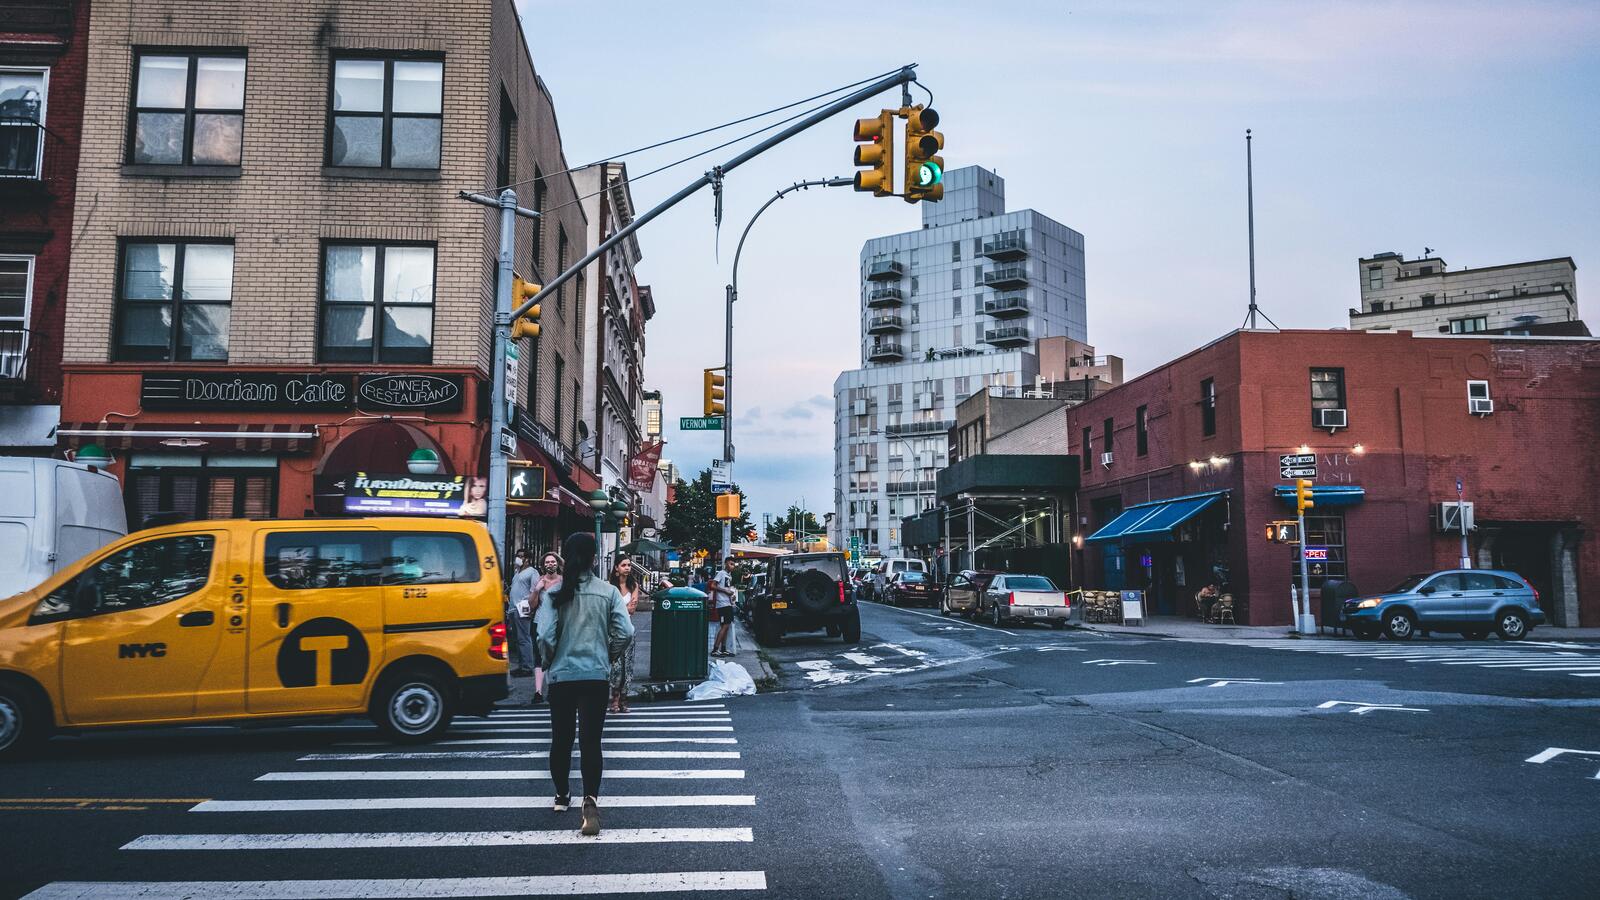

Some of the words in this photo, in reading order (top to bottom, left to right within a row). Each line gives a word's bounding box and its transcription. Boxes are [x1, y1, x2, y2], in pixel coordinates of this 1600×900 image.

[186, 379, 277, 401] Dorian
[285, 379, 346, 402] Cafe
[365, 383, 452, 403] RESTAURANT
[389, 379, 431, 392] DINER
[681, 418, 707, 429] VERNON
[119, 642, 167, 659] NYC
[300, 634, 349, 687] T
